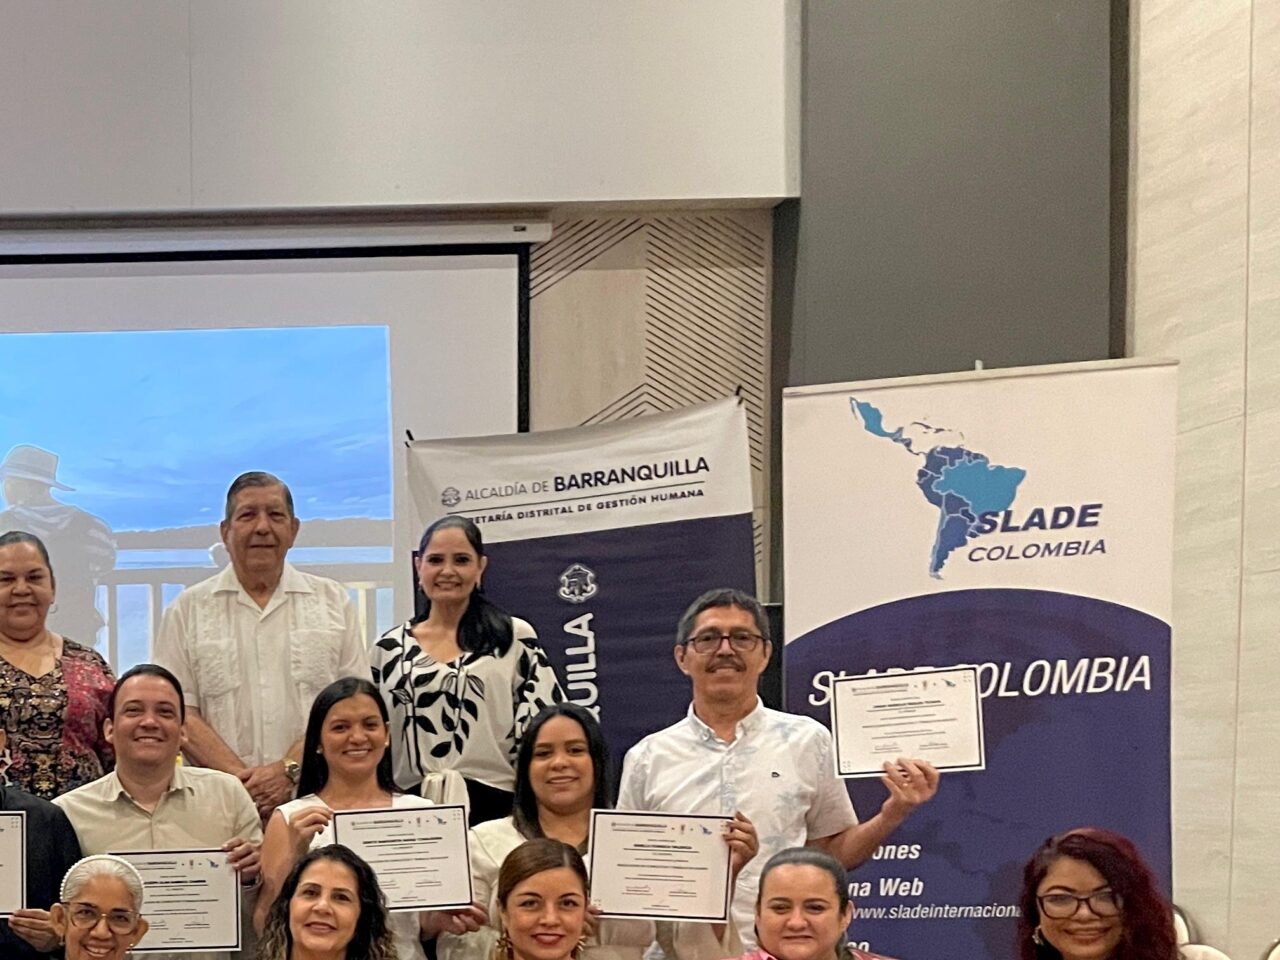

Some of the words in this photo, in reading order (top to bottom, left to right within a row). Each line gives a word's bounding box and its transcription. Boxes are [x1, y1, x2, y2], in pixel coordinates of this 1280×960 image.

[464, 481, 527, 501] ALCALDÍA
[532, 481, 549, 494] DE
[554, 456, 710, 492] BARRANQUILLA
[517, 505, 574, 519] DISTRITAL
[578, 503, 592, 513] DE
[596, 495, 647, 510] GESTIÓN
[651, 489, 704, 503] HUMANA
[975, 503, 1104, 534] SLADE
[968, 538, 1107, 562] COLOMBIA
[563, 612, 601, 723] UILLA
[960, 655, 1152, 698] OLOMBIA
[872, 844, 922, 860] ones
[847, 882, 872, 897] na
[880, 877, 924, 897] Web
